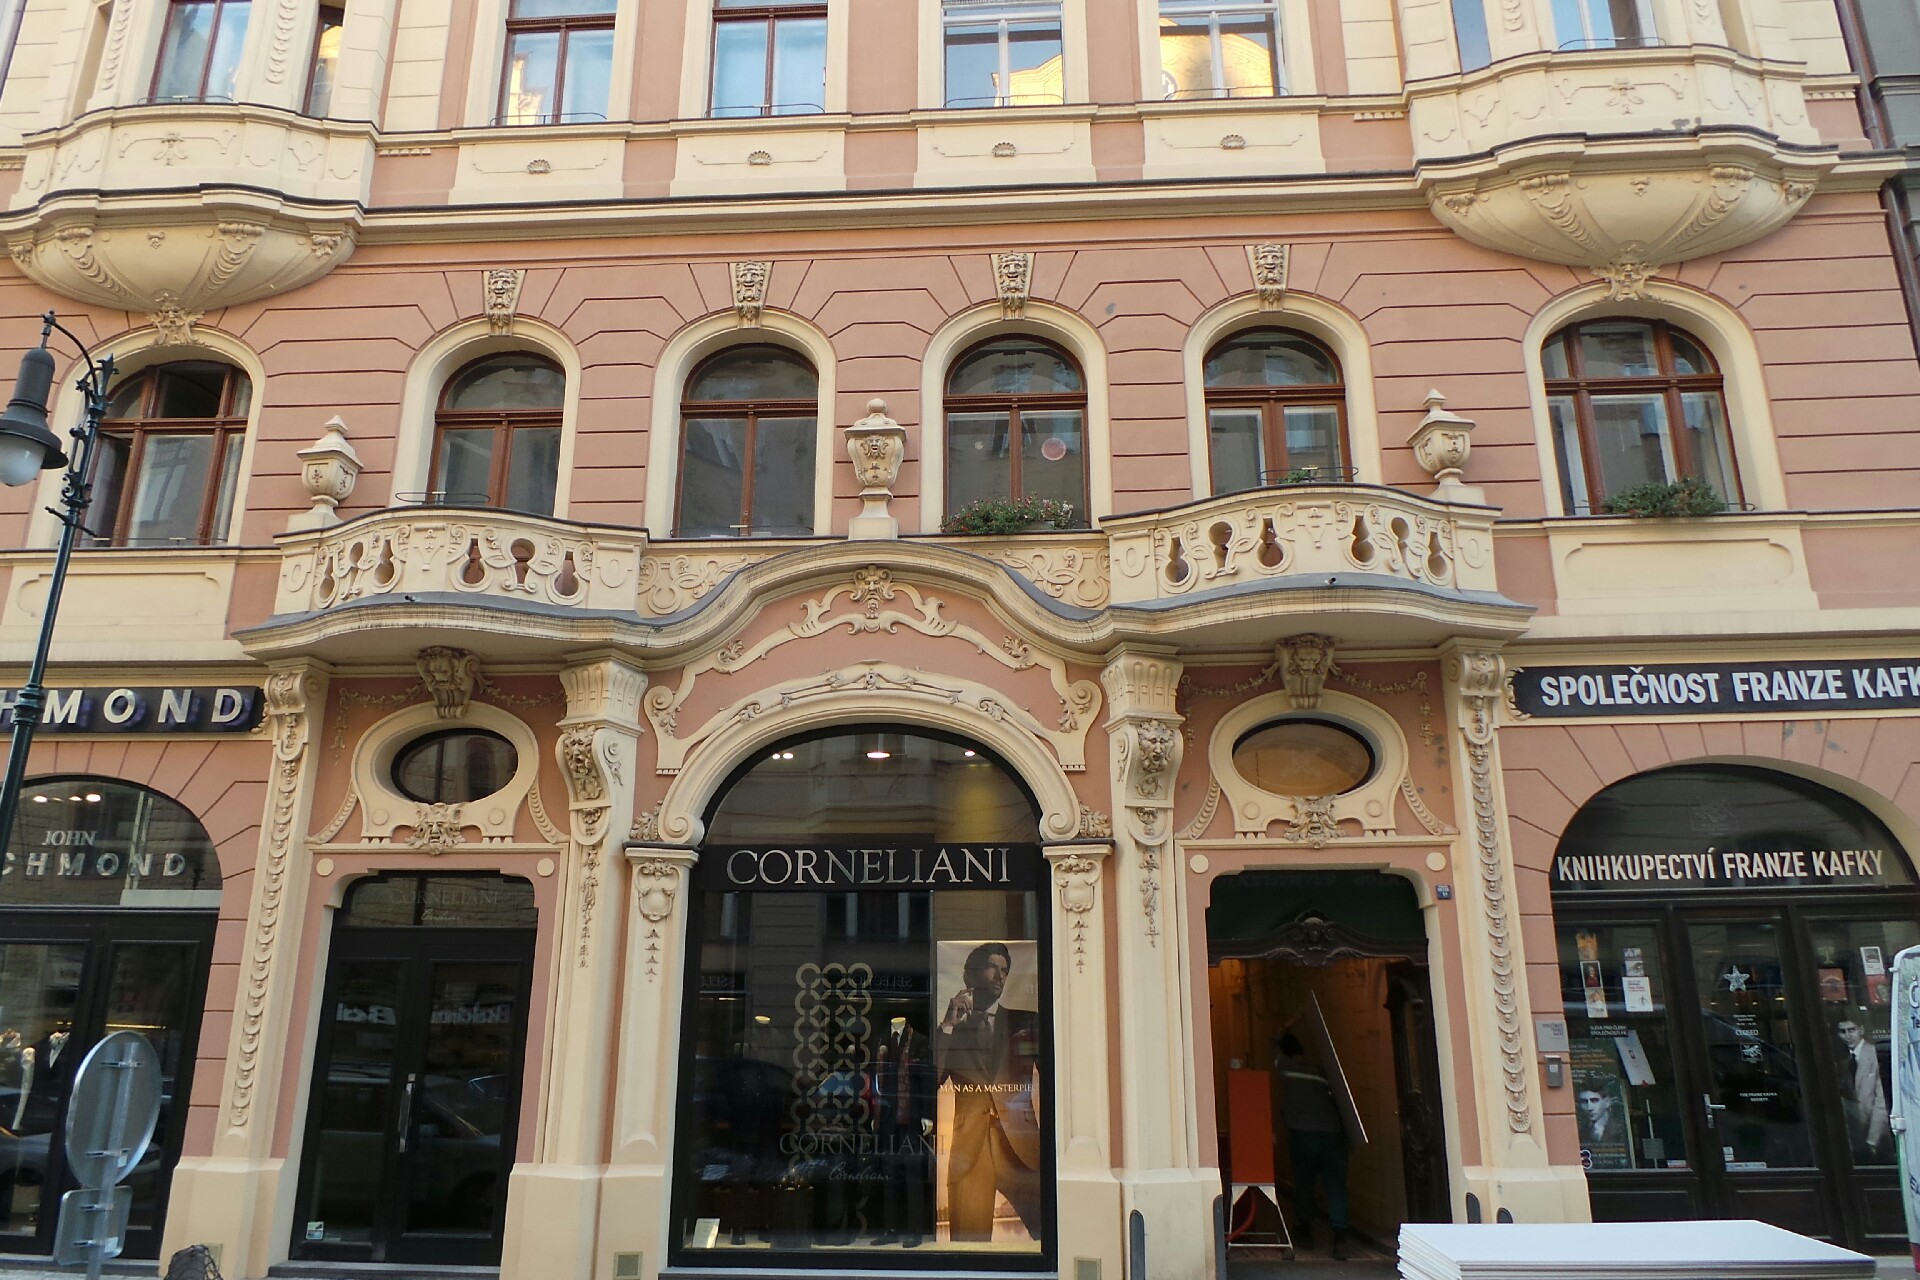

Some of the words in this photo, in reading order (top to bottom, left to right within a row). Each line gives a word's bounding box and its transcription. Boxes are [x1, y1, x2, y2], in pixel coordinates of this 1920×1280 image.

[1540, 667, 1719, 706] SPOLEČNOST
[1731, 669, 1847, 702] FRANZE
[41, 830, 97, 846] JOHN
[727, 847, 1016, 884] CORNELIANI
[1557, 847, 1716, 881] KNIHKUPECTVÍ
[1722, 851, 1808, 879] FRANZE
[1811, 849, 1882, 877] KAFKY
[939, 1083, 960, 1093] MAN
[962, 1083, 974, 1092] AS
[974, 1083, 982, 1092] A
[779, 1132, 947, 1156] CORNELIANI
